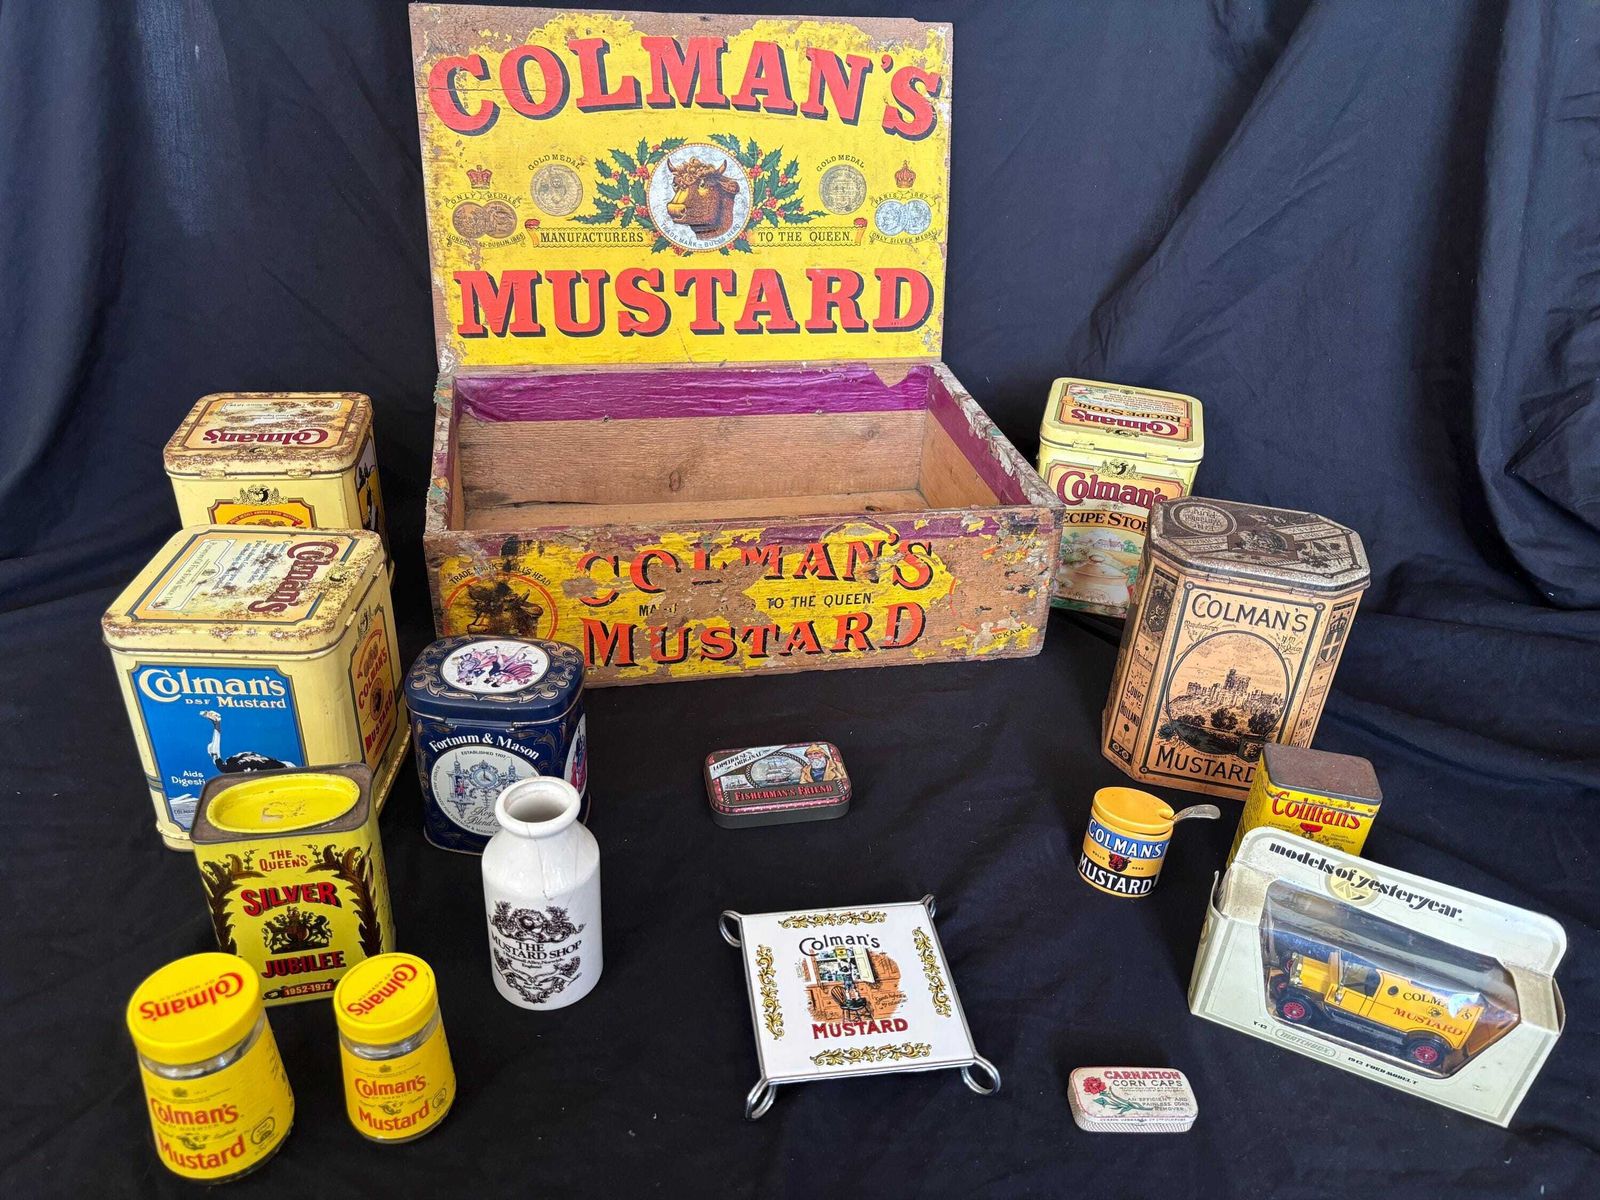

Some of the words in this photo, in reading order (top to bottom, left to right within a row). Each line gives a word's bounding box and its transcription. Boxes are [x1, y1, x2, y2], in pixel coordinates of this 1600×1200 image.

[427, 35, 943, 141] COLMAN'S
[528, 155, 551, 171] GOLD
[552, 154, 581, 170] MEDAL
[816, 156, 837, 172] GOLD
[838, 155, 865, 169] MEDAL
[540, 231, 644, 244] MANUFACTURERS
[680, 237, 697, 247] MARK
[758, 230, 773, 242] TO
[778, 230, 803, 242] THE
[809, 230, 853, 243] QUEEN.
[454, 266, 935, 337] MUSTARD
[1073, 401, 1124, 417] STORE
[1126, 408, 1181, 423] RECIPE
[1071, 409, 1179, 437] Colman's
[203, 428, 329, 445] Colman's
[1064, 512, 1106, 524] ECIPE
[1108, 512, 1148, 531] STO
[247, 541, 340, 615] Colman's
[449, 568, 473, 584] TRADE
[532, 571, 551, 587] HEAD
[767, 597, 784, 609] TO
[792, 595, 816, 607] THE
[824, 593, 875, 606] QUEEN.
[1192, 592, 1309, 633] COLMAN'S
[580, 602, 927, 668] MUSTARD
[138, 668, 286, 703] Colman's
[358, 647, 387, 710] COLMAN'S
[217, 696, 287, 709] Mustard
[428, 734, 480, 753] Fortnum
[482, 733, 494, 745] &
[495, 735, 539, 761] Mason
[171, 775, 206, 787] Digesti
[183, 770, 204, 778] Aids
[735, 788, 796, 802] FISHERMAN'S
[798, 784, 833, 796] FRIEND
[465, 816, 493, 827] Blend
[471, 806, 496, 819] Roy
[1088, 818, 1163, 858] COLMAN'S
[259, 854, 309, 872] QUEEN'S
[269, 850, 293, 860] THE
[1269, 842, 1335, 876] models
[1335, 865, 1356, 885] of
[1079, 852, 1152, 894] MUSTARD
[240, 881, 343, 918] SILVER
[491, 931, 548, 961] MUSTARD
[549, 940, 582, 960] SHOP
[516, 941, 545, 952] THE
[799, 934, 881, 957] Colman's
[261, 951, 347, 979] JUBILEE
[139, 971, 244, 1022] Colman's
[284, 982, 333, 997] 1952-1977
[347, 963, 418, 1017] Colman's
[1402, 992, 1473, 1021] COLM'S
[812, 1018, 909, 1040] MUSTARD
[1393, 1006, 1465, 1037] MUSTARD
[1104, 1070, 1181, 1080] CARNATION
[1365, 1061, 1386, 1074] FORD
[355, 1075, 427, 1098] Colman's
[150, 1097, 240, 1125] Colman's
[358, 1099, 430, 1131] Mustard
[157, 1133, 247, 1170] Mustard
